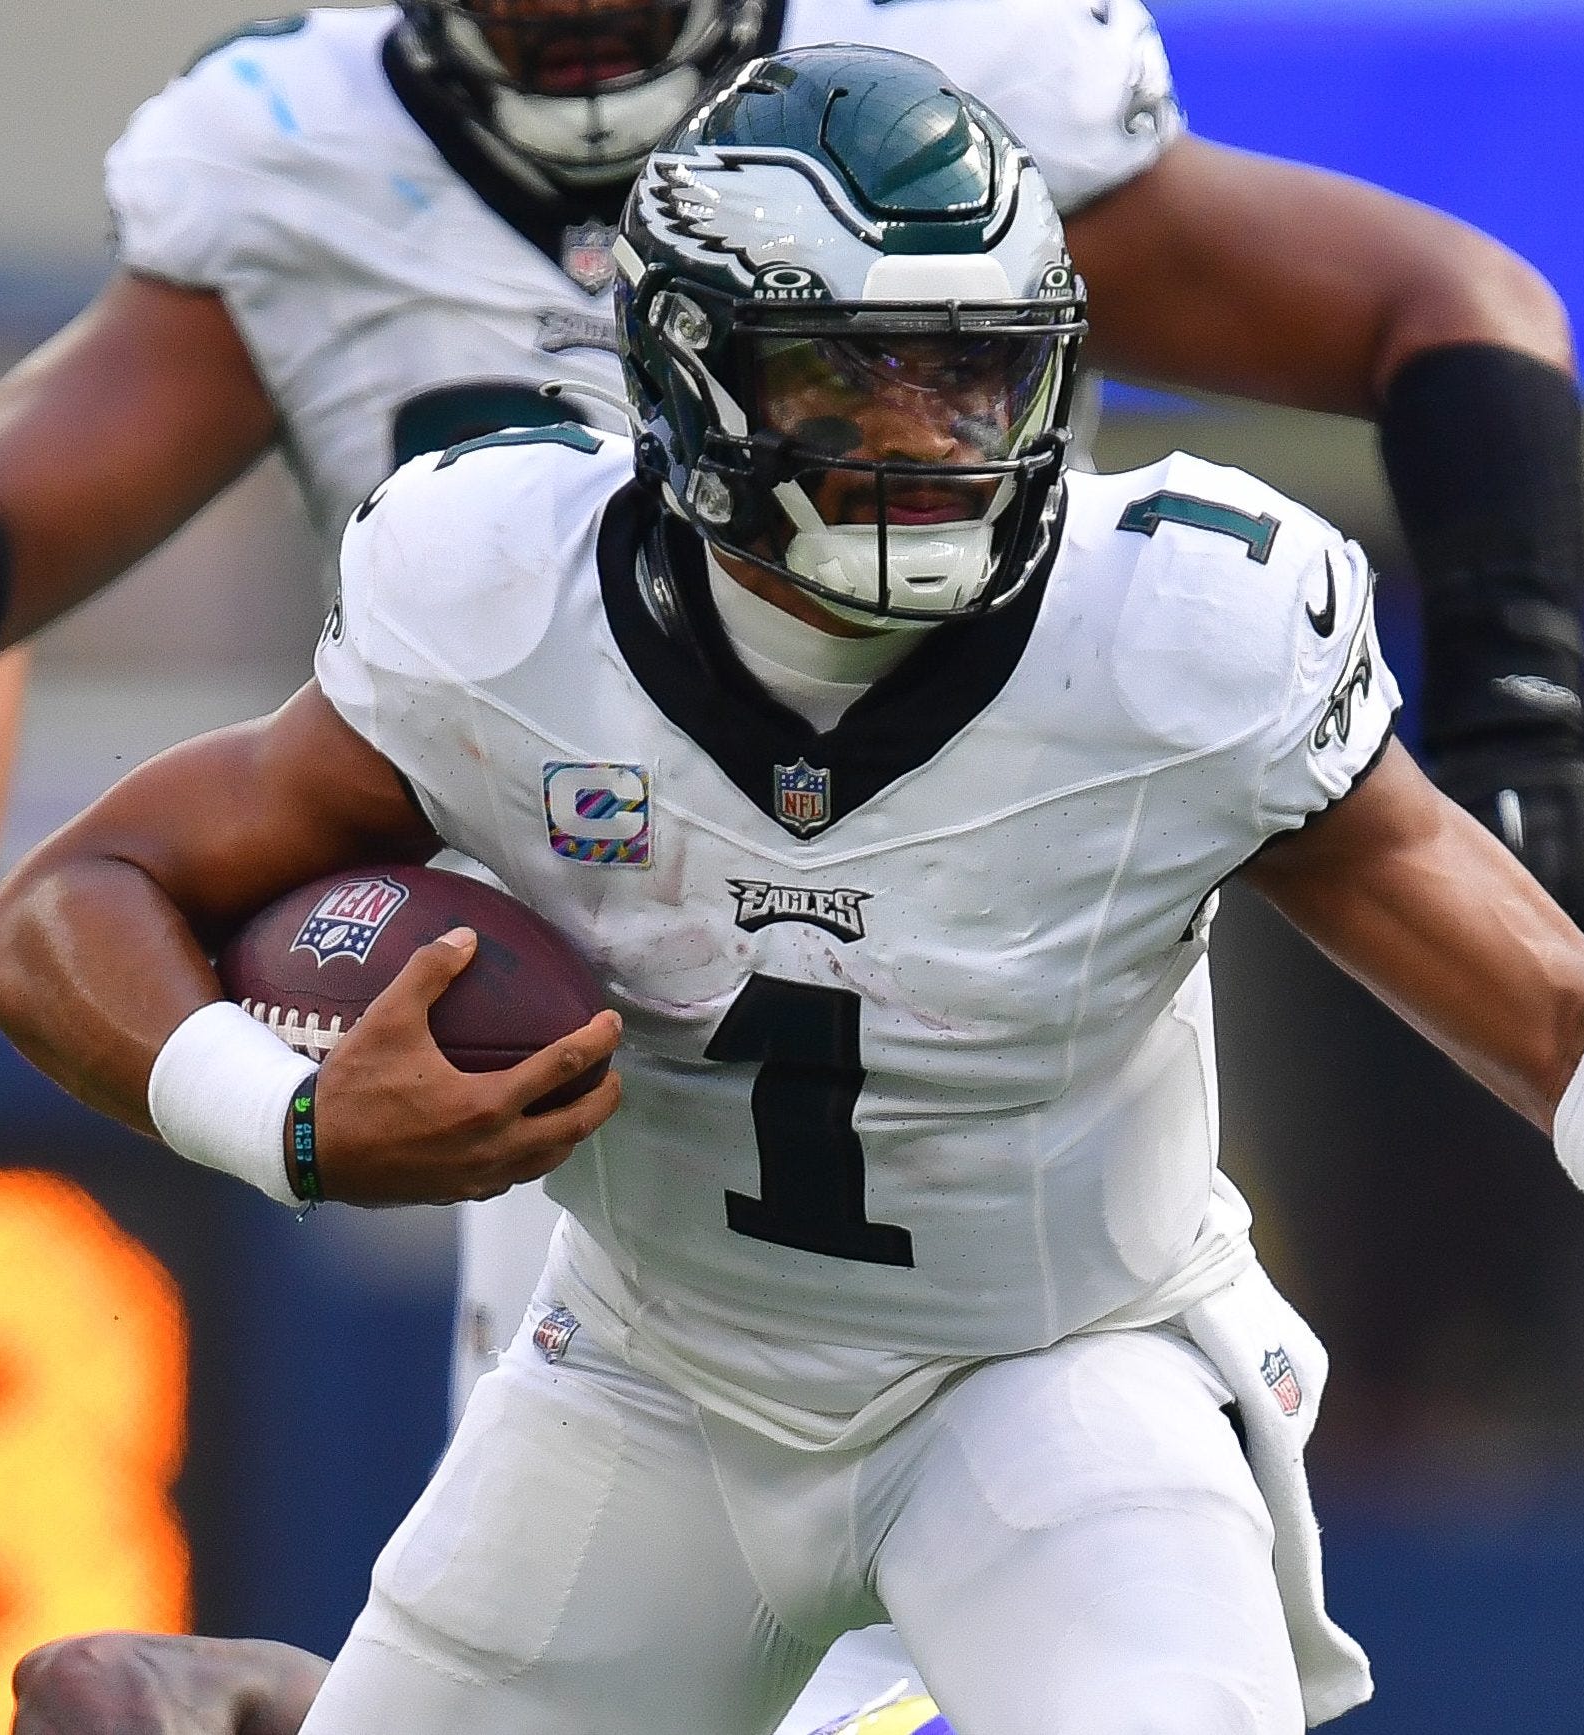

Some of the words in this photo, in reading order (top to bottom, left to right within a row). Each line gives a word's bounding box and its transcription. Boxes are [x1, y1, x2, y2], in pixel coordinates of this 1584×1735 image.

[754, 288, 824, 299] OAKLEY
[1115, 489, 1282, 566] 1
[326, 882, 398, 923] NFL
[725, 878, 875, 944] EAGLES
[702, 971, 915, 1269] 1
